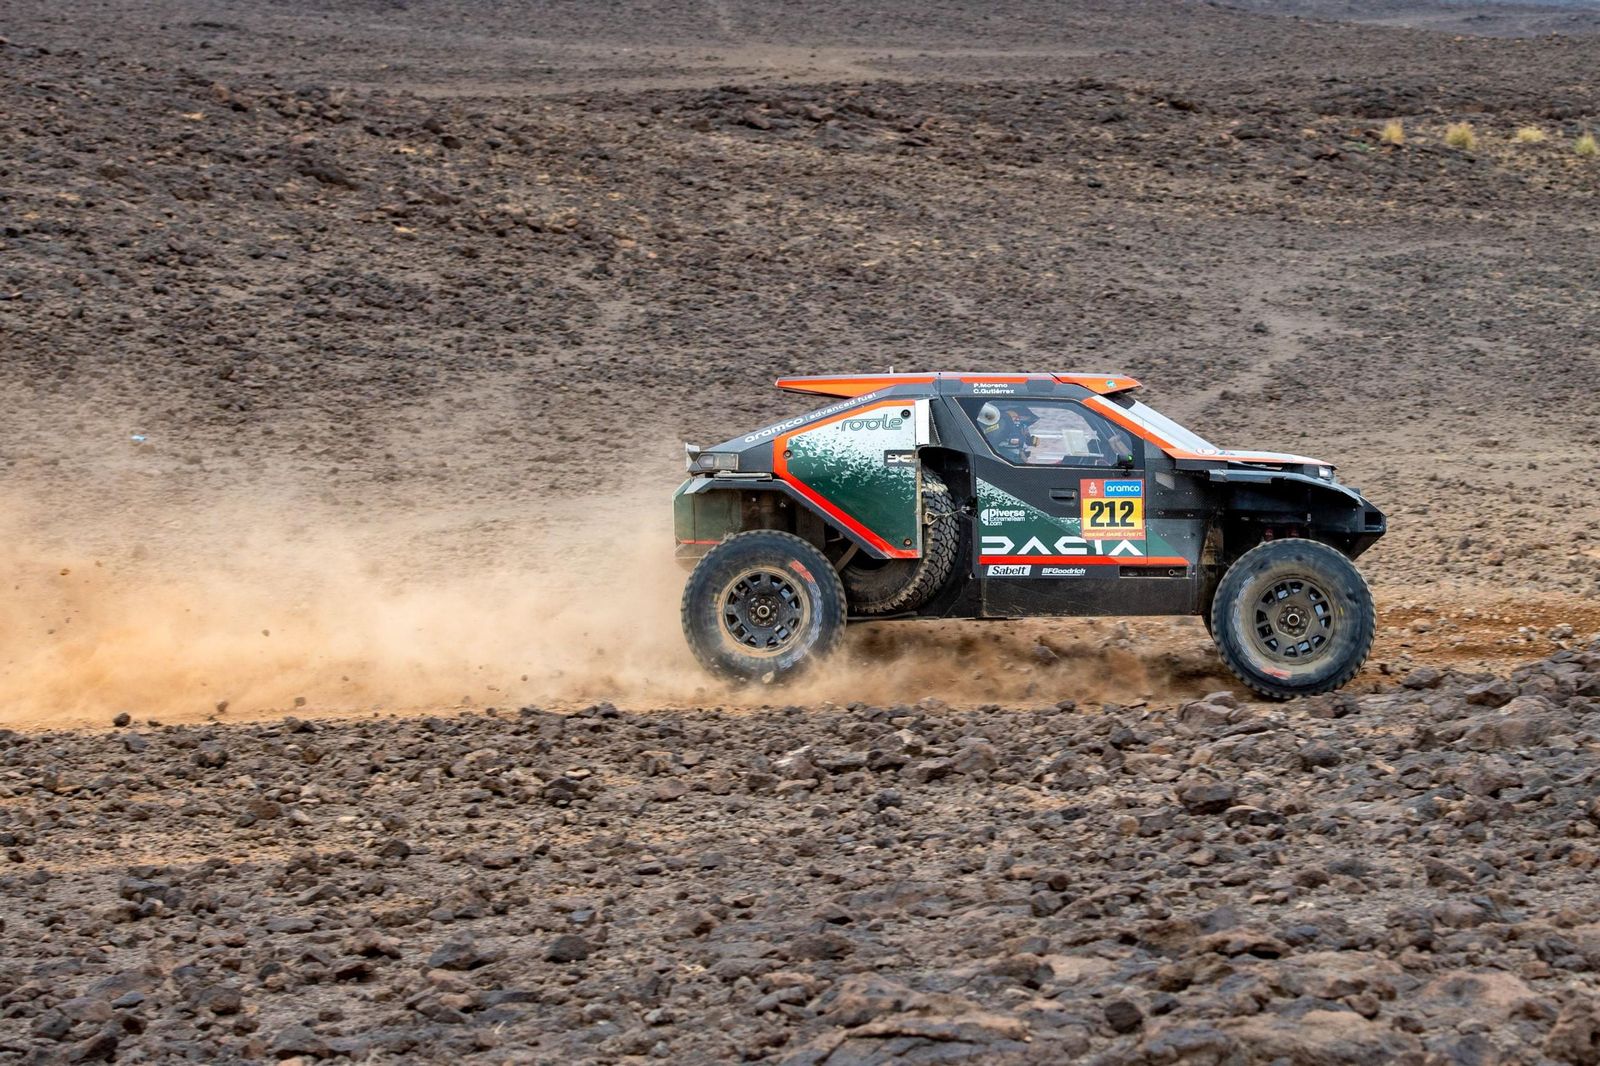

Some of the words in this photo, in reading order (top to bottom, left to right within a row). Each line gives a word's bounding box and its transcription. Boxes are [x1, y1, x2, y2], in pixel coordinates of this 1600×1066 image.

[744, 418, 804, 443] aramco
[809, 400, 856, 419] advanced
[857, 392, 877, 403] fuel
[841, 413, 903, 432] roole
[1106, 484, 1140, 493] aramco
[989, 508, 1026, 517] Diverse
[1090, 501, 1134, 528] 212
[981, 536, 1144, 556] DACIA
[991, 565, 1026, 575] Sabelt
[1041, 567, 1086, 575] BFGoodrich
